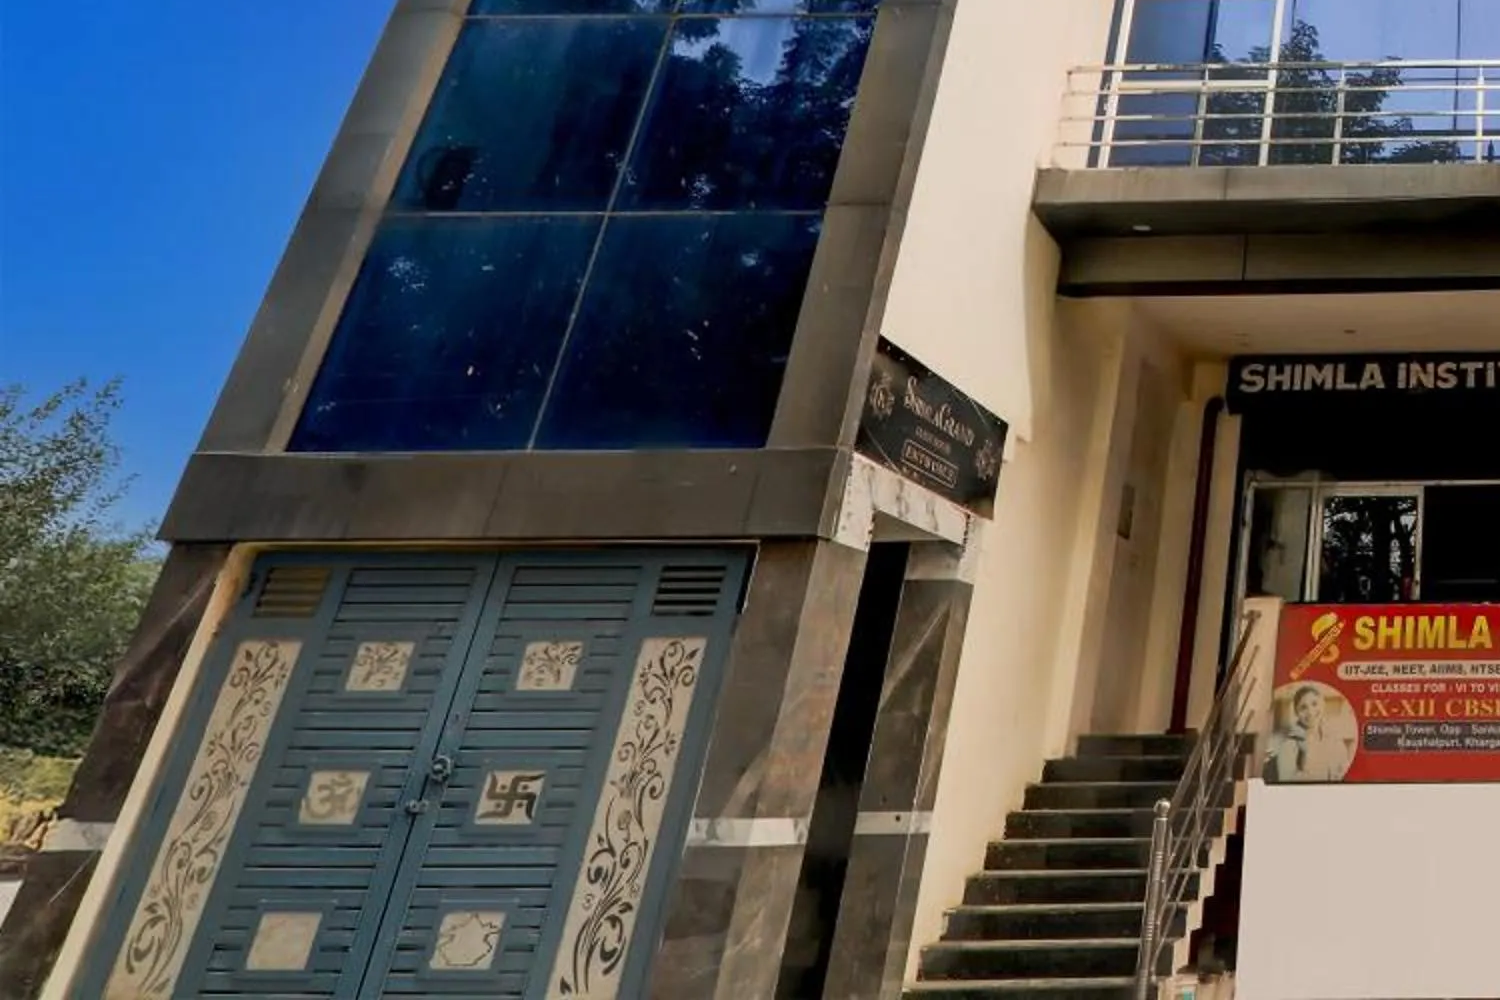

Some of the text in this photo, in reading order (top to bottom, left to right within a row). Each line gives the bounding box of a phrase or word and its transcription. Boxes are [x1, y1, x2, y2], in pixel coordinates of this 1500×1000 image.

[1239, 362, 1384, 392] SHIMLA
[1353, 615, 1493, 650] SHIMLA
[1364, 698, 1436, 718] IX-XII
